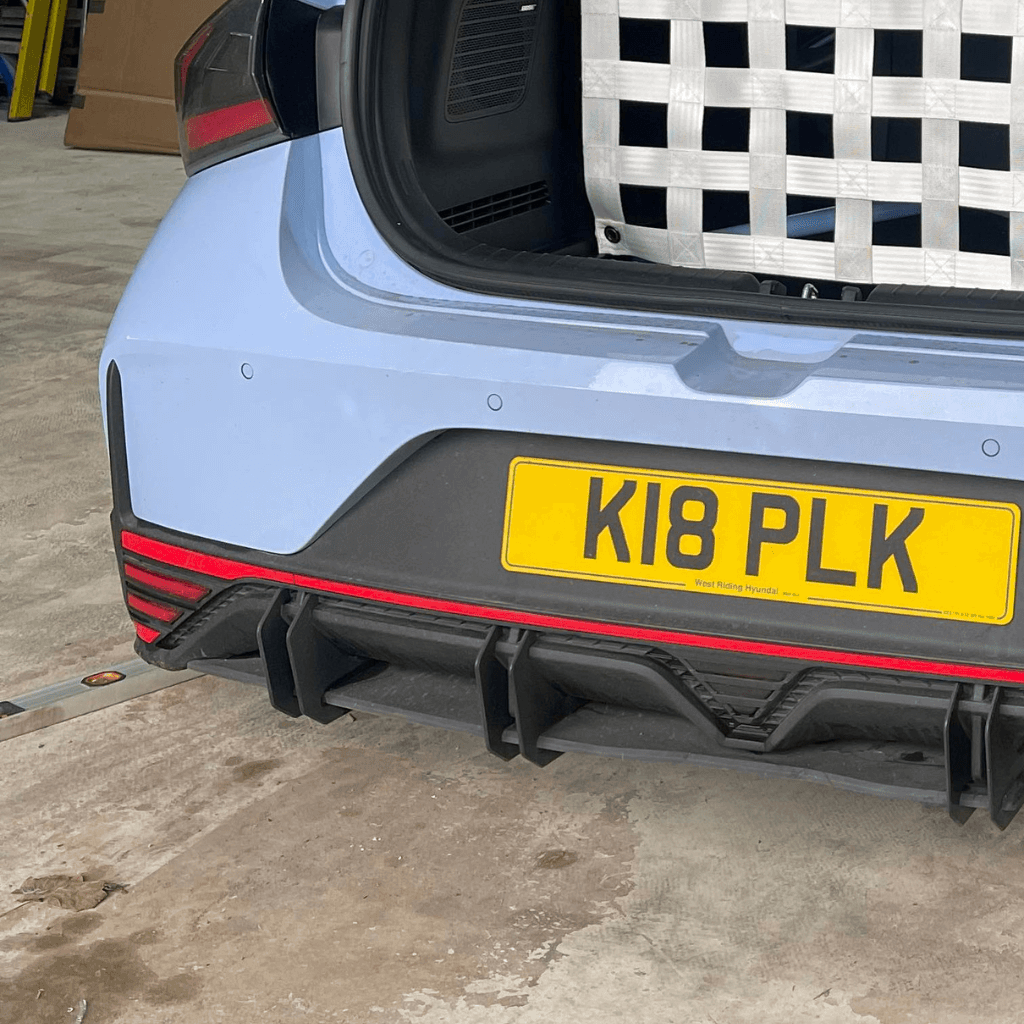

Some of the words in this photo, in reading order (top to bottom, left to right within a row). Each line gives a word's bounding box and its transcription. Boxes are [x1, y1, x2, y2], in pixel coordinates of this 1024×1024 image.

[584, 476, 719, 571] K18
[745, 491, 925, 594] PLK
[694, 578, 715, 589] West
[717, 581, 743, 593] Riding
[745, 584, 779, 595] Hyundai
